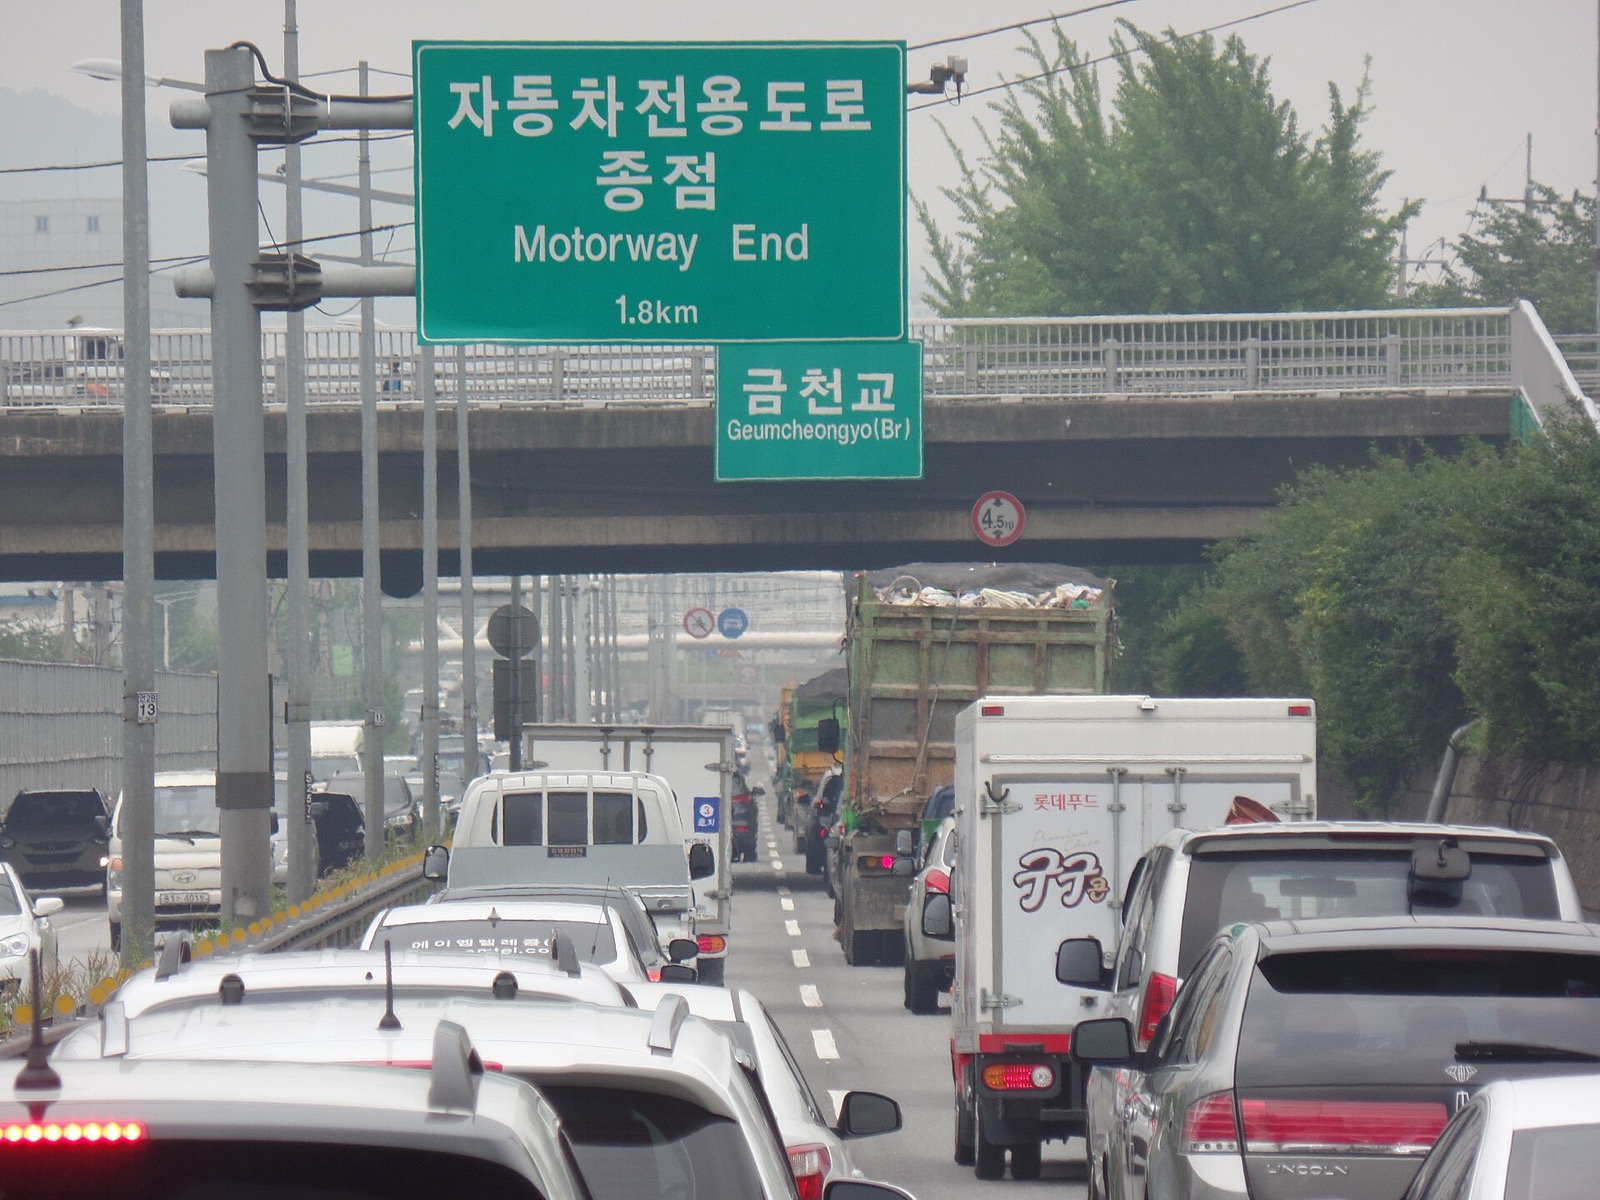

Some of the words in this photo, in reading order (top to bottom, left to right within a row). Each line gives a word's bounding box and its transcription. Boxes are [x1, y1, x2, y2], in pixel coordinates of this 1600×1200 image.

[447, 75, 872, 138] 자동차전용도로
[596, 150, 716, 212] 종점
[514, 224, 699, 272] Motorway
[732, 223, 809, 261] End
[615, 294, 699, 325] 1.8km
[742, 367, 896, 416] 금천교
[727, 418, 912, 445] Geumcheongyo(Br)
[139, 703, 156, 716] 13
[1034, 793, 1100, 811] 롯데푸드
[1266, 1163, 1348, 1176] LINCOLN
